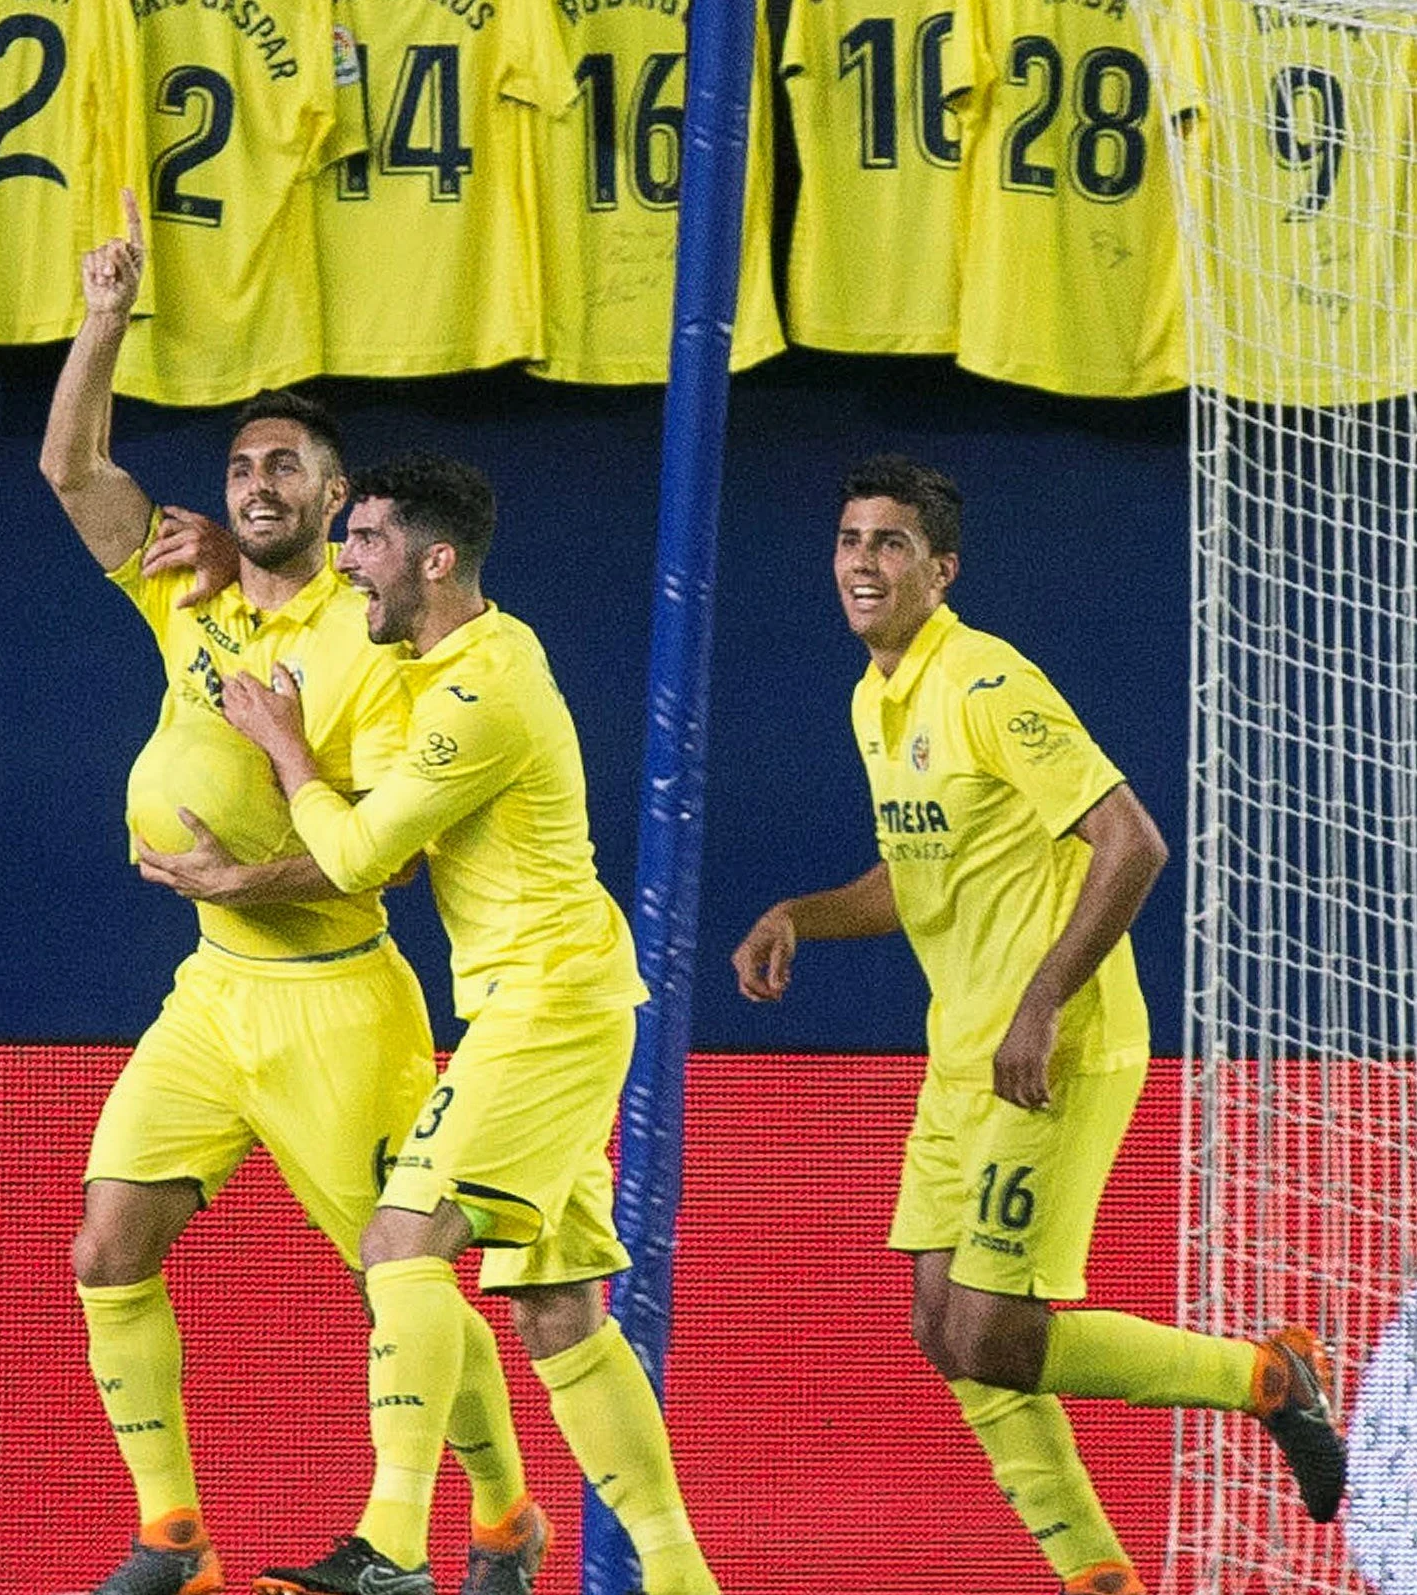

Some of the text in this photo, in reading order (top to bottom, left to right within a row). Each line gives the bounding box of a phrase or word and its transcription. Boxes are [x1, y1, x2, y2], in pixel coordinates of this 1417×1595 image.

[149, 63, 235, 228] 2
[573, 52, 686, 212] 16
[998, 34, 1150, 206] 28
[1266, 63, 1346, 223] 9
[415, 1085, 454, 1139] 3
[978, 1162, 1034, 1231] 16
